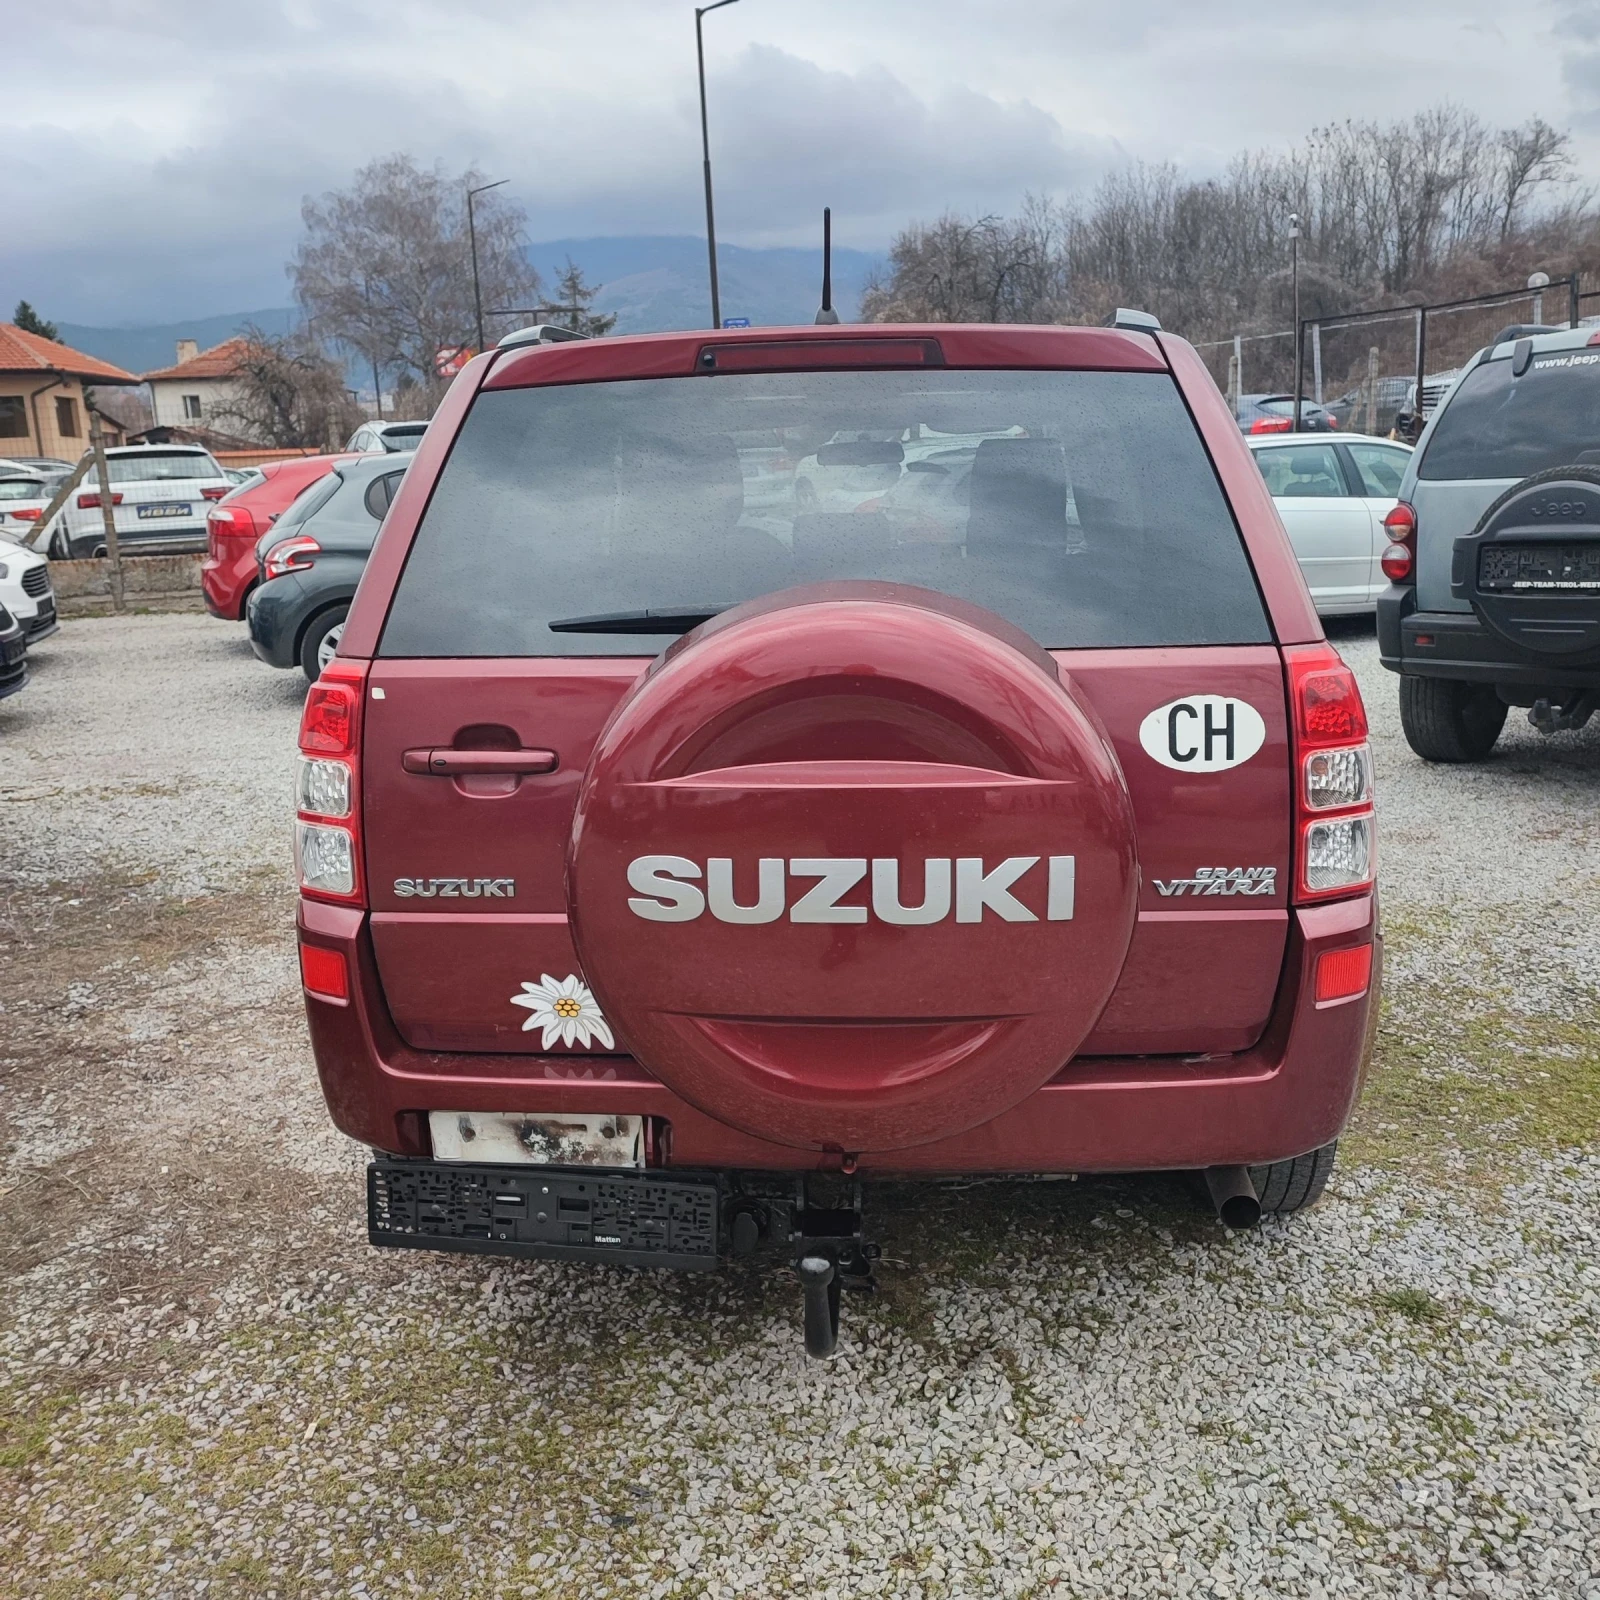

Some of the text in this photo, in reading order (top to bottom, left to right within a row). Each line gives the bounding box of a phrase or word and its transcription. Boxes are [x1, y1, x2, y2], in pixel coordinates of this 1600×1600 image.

[1534, 354, 1600, 369] www.jeep
[1168, 703, 1235, 762] CH
[1195, 867, 1277, 879] GRAND
[393, 878, 515, 898] SUZUKI
[627, 855, 1075, 924] SUZUKI
[1152, 879, 1276, 896] VITARA
[594, 1235, 621, 1244] Matten
